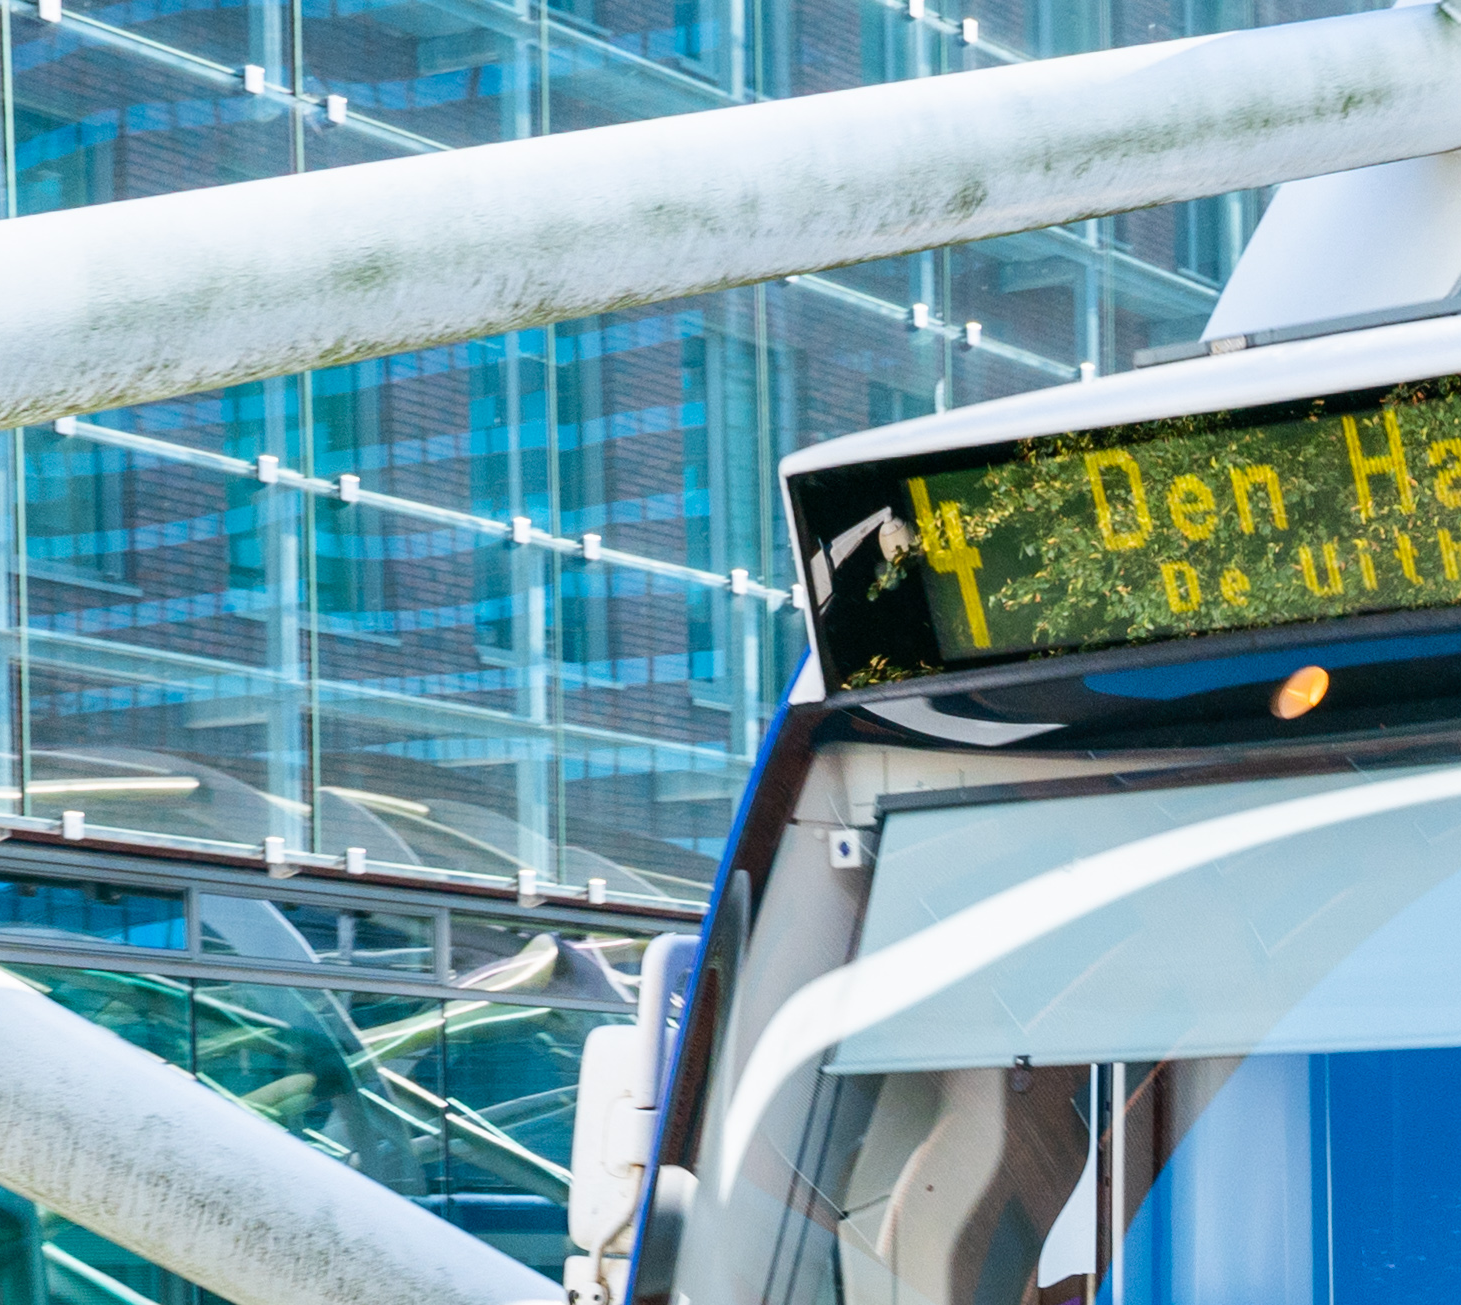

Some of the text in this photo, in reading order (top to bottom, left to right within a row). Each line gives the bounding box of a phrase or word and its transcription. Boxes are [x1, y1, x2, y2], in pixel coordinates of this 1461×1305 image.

[907, 476, 991, 649] 4
[1084, 447, 1289, 551] Den
[1160, 560, 1252, 614] De
